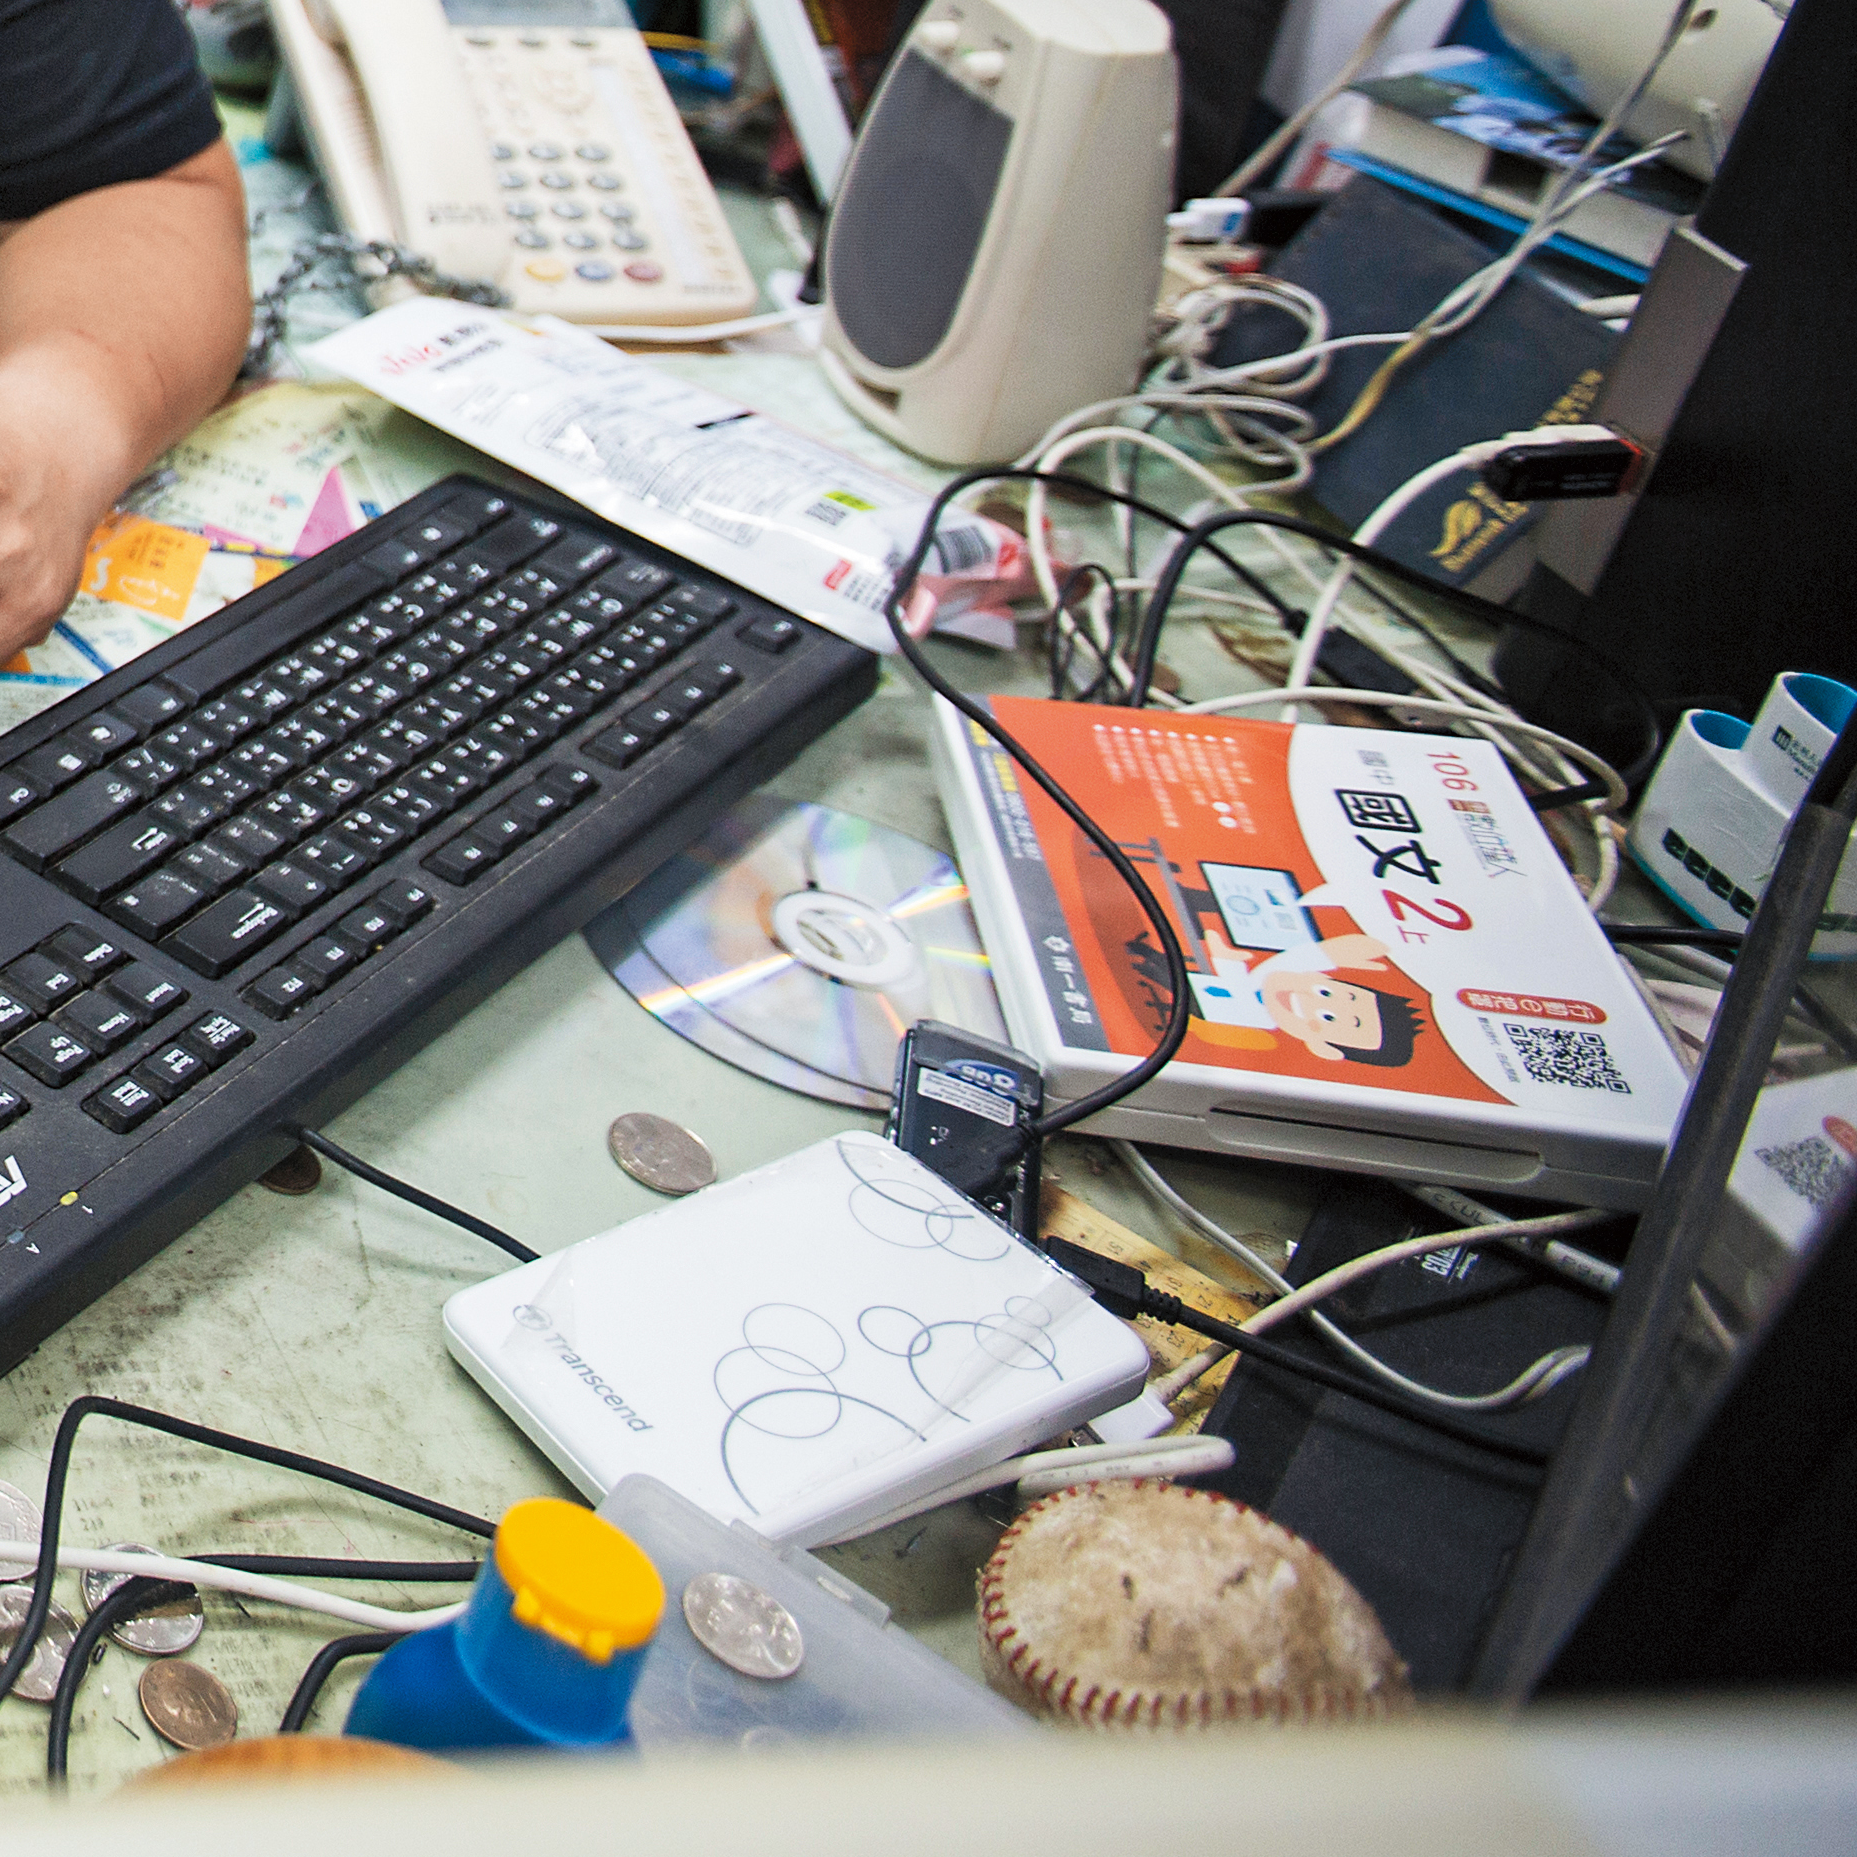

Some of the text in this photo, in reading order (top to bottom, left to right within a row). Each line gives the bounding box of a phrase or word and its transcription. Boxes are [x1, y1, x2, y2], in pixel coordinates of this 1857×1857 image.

[1426, 751, 1480, 793] 106
[1053, 955, 1093, 1027] 南一書局
[98, 1012, 130, 1033] Home
[545, 1328, 655, 1433] Transcend
